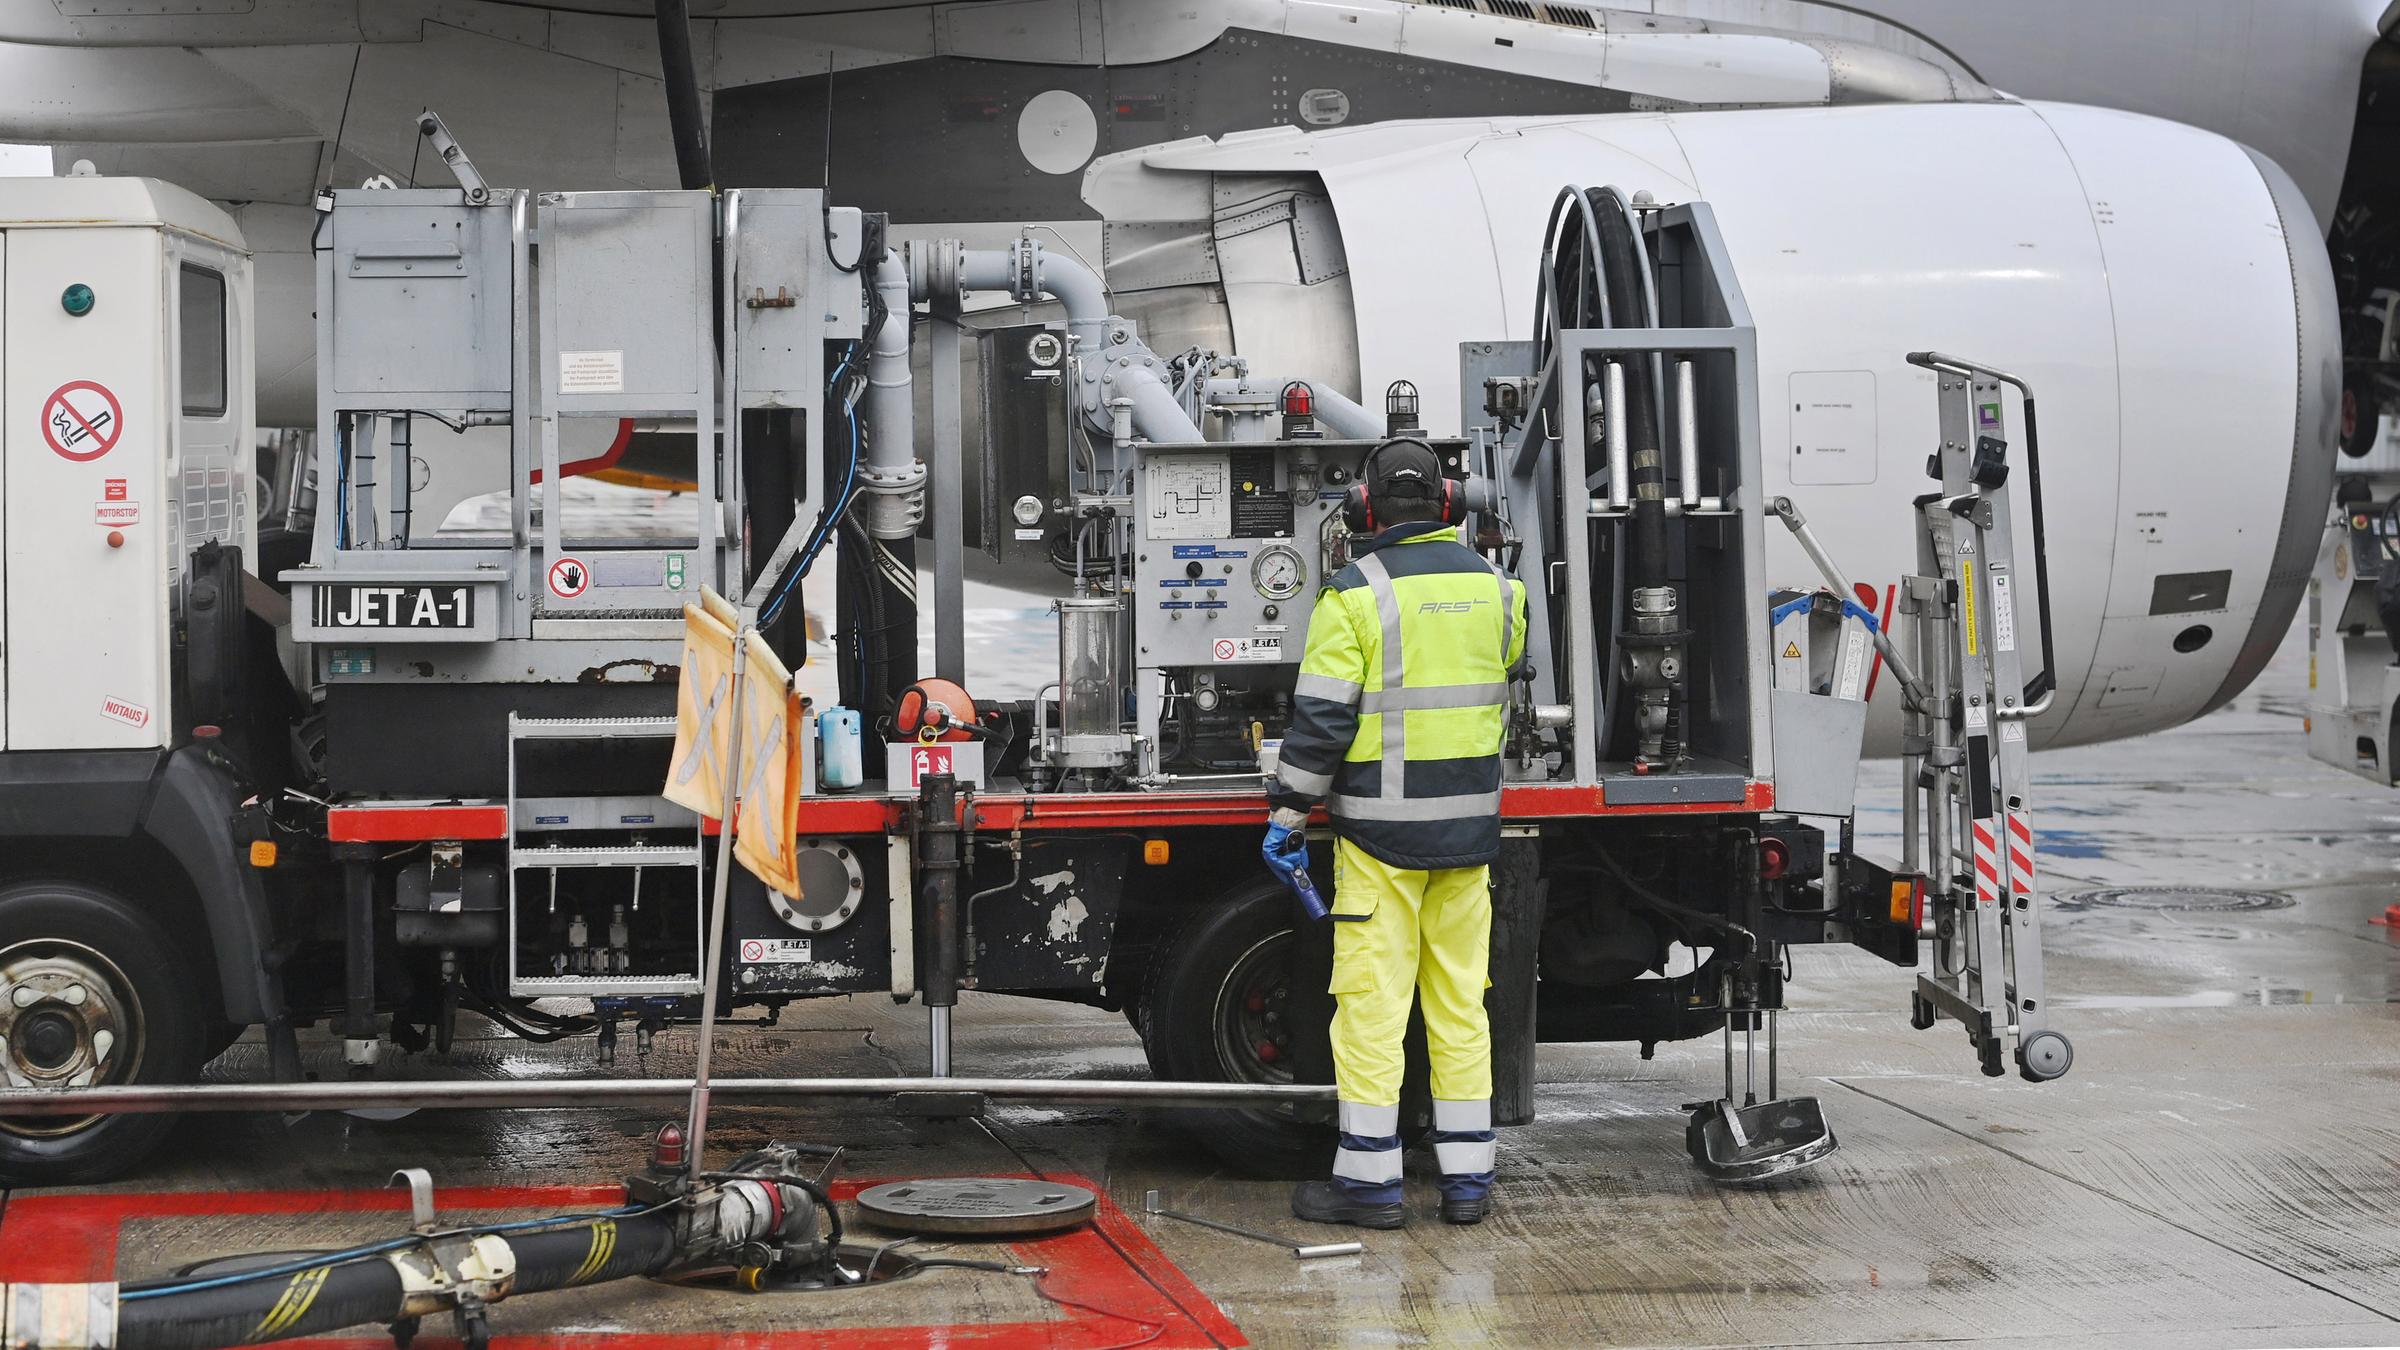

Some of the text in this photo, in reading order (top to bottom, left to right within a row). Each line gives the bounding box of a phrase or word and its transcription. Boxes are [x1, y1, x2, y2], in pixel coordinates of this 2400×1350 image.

[97, 508, 137, 518] MOTORSTOP
[337, 588, 467, 626] JET A-1
[1418, 602, 1472, 614] AFS
[105, 701, 142, 722] NOTAUS
